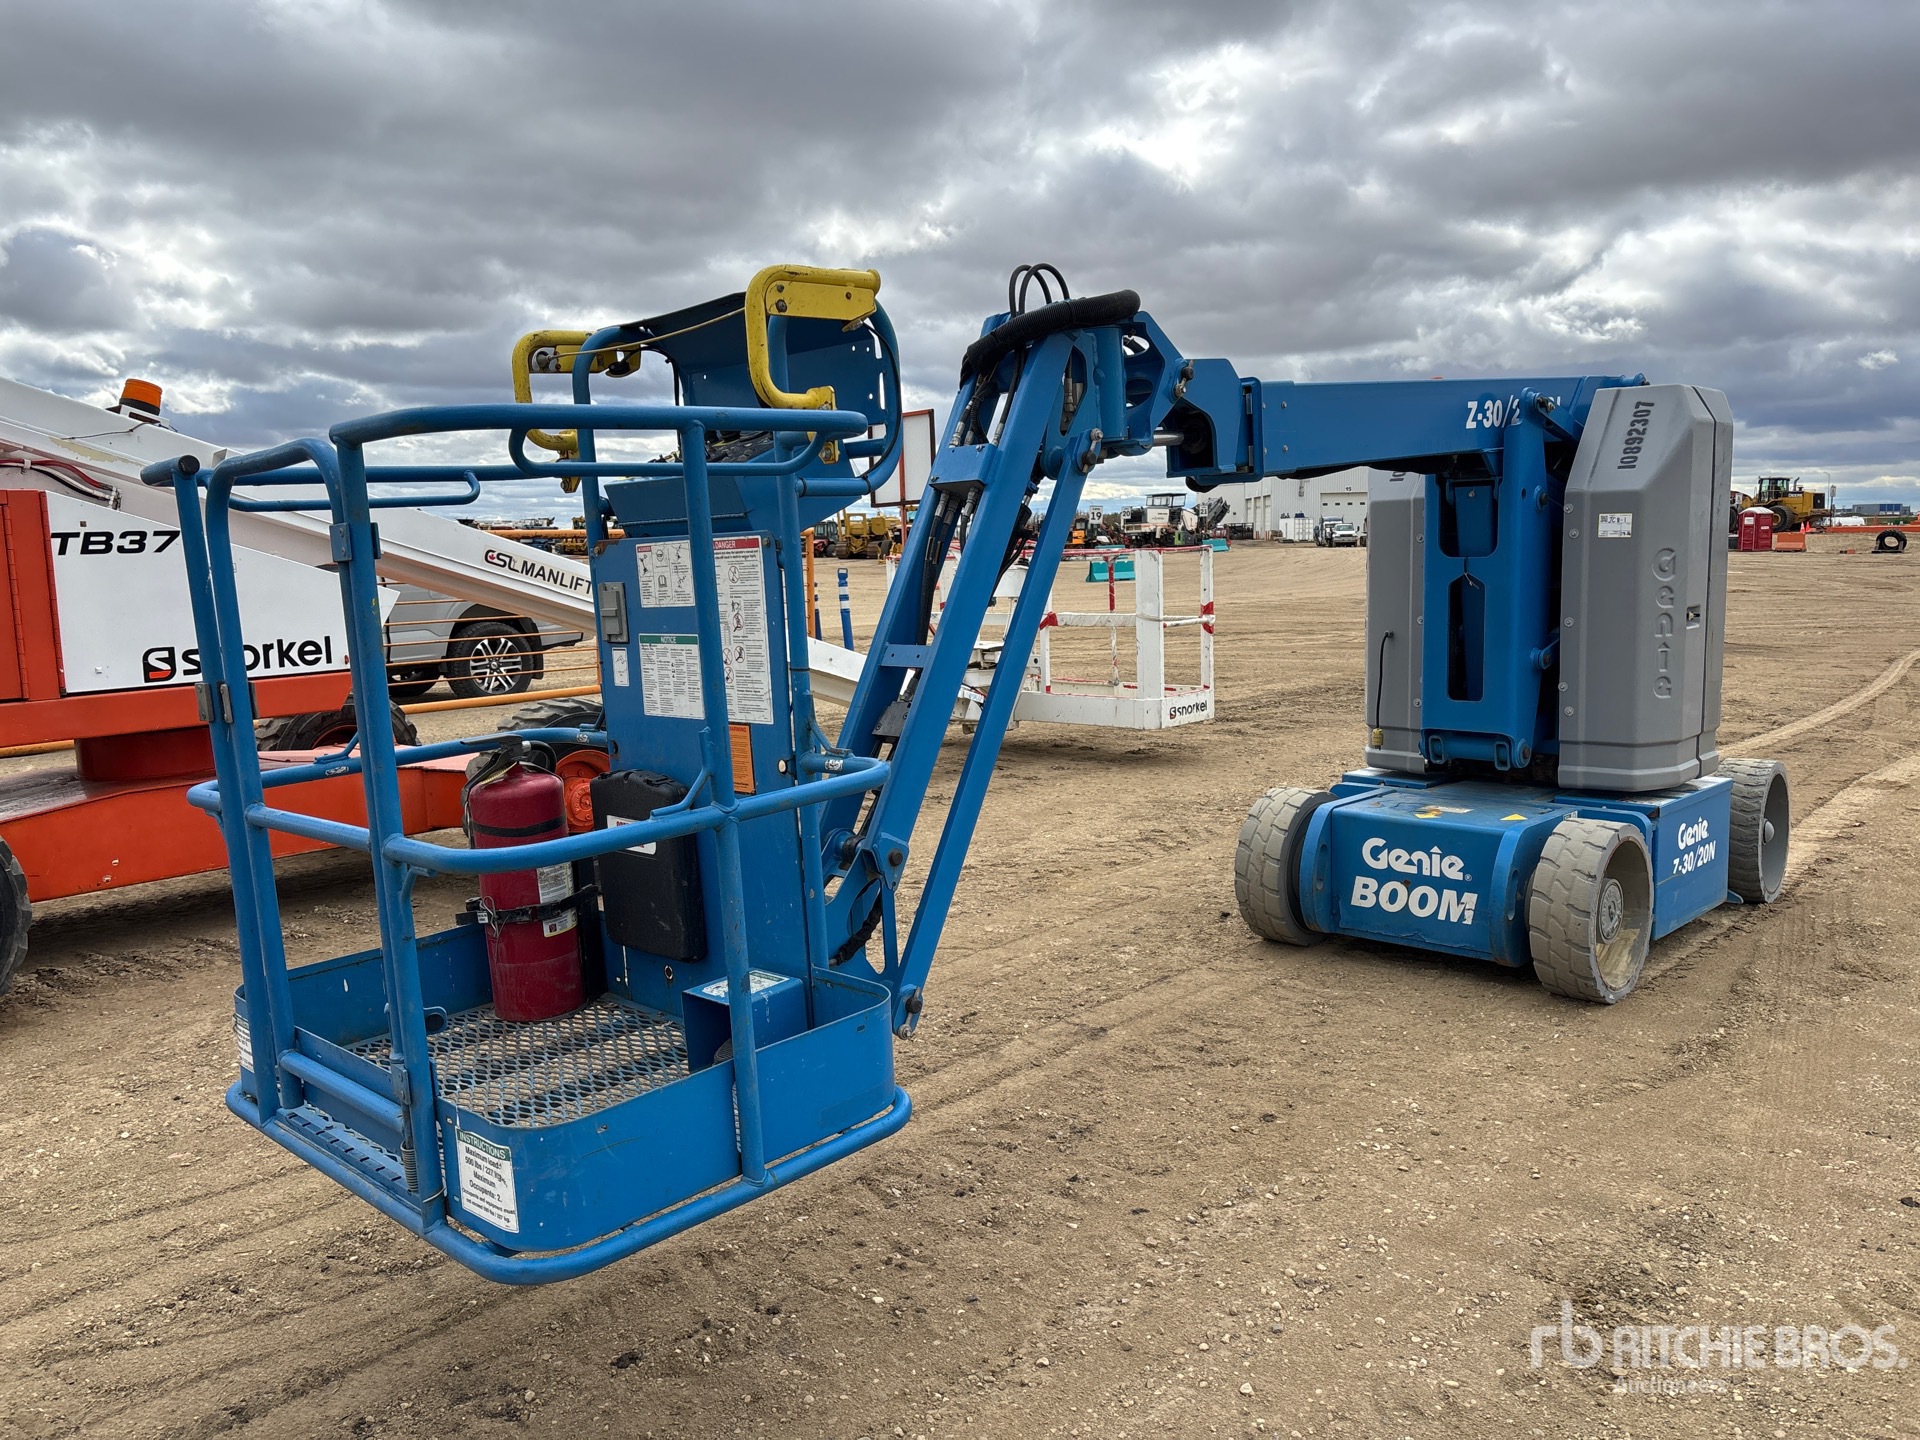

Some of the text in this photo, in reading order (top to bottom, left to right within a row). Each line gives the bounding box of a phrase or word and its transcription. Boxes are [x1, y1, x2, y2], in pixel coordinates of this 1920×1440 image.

[1090, 511, 1102, 521] 19
[51, 530, 181, 556] TB37
[714, 541, 736, 549] DANGER
[660, 636, 677, 644] NOTICE
[181, 635, 333, 676] sorkel
[1177, 700, 1208, 716] snorkel
[1678, 816, 1709, 850] Genie
[1350, 875, 1479, 925] BOOM
[459, 1131, 506, 1161] INSTRUCTIONS
[465, 1145, 488, 1164] Maximum
[473, 1170, 496, 1188] Maximum
